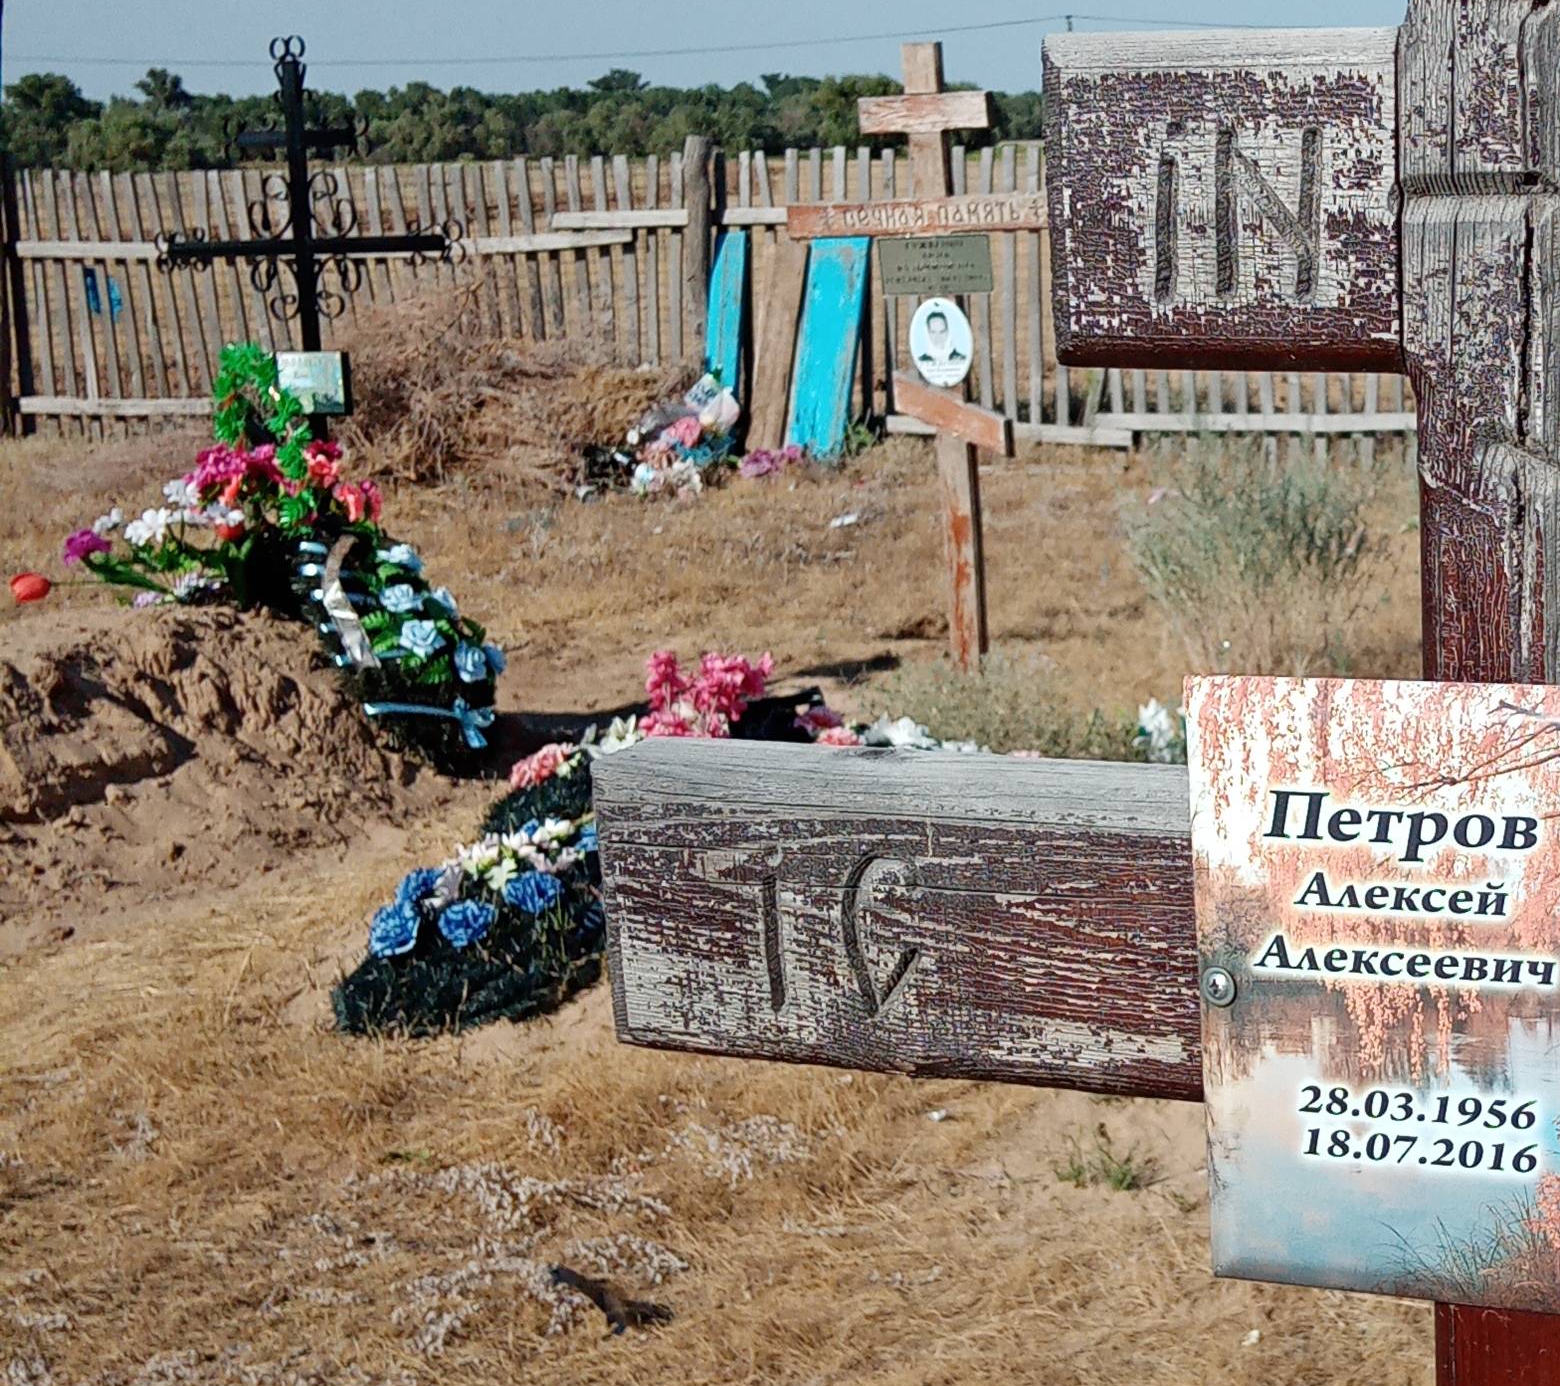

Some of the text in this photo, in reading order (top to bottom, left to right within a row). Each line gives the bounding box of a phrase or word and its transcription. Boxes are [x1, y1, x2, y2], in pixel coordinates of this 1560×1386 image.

[1263, 789, 1539, 863] Петров
[1293, 871, 1509, 917] Алексей
[1256, 934, 1557, 986] Алексеевич
[1298, 1084, 1539, 1130] 28.03.1956
[1302, 1127, 1539, 1174] 18.07.2016
